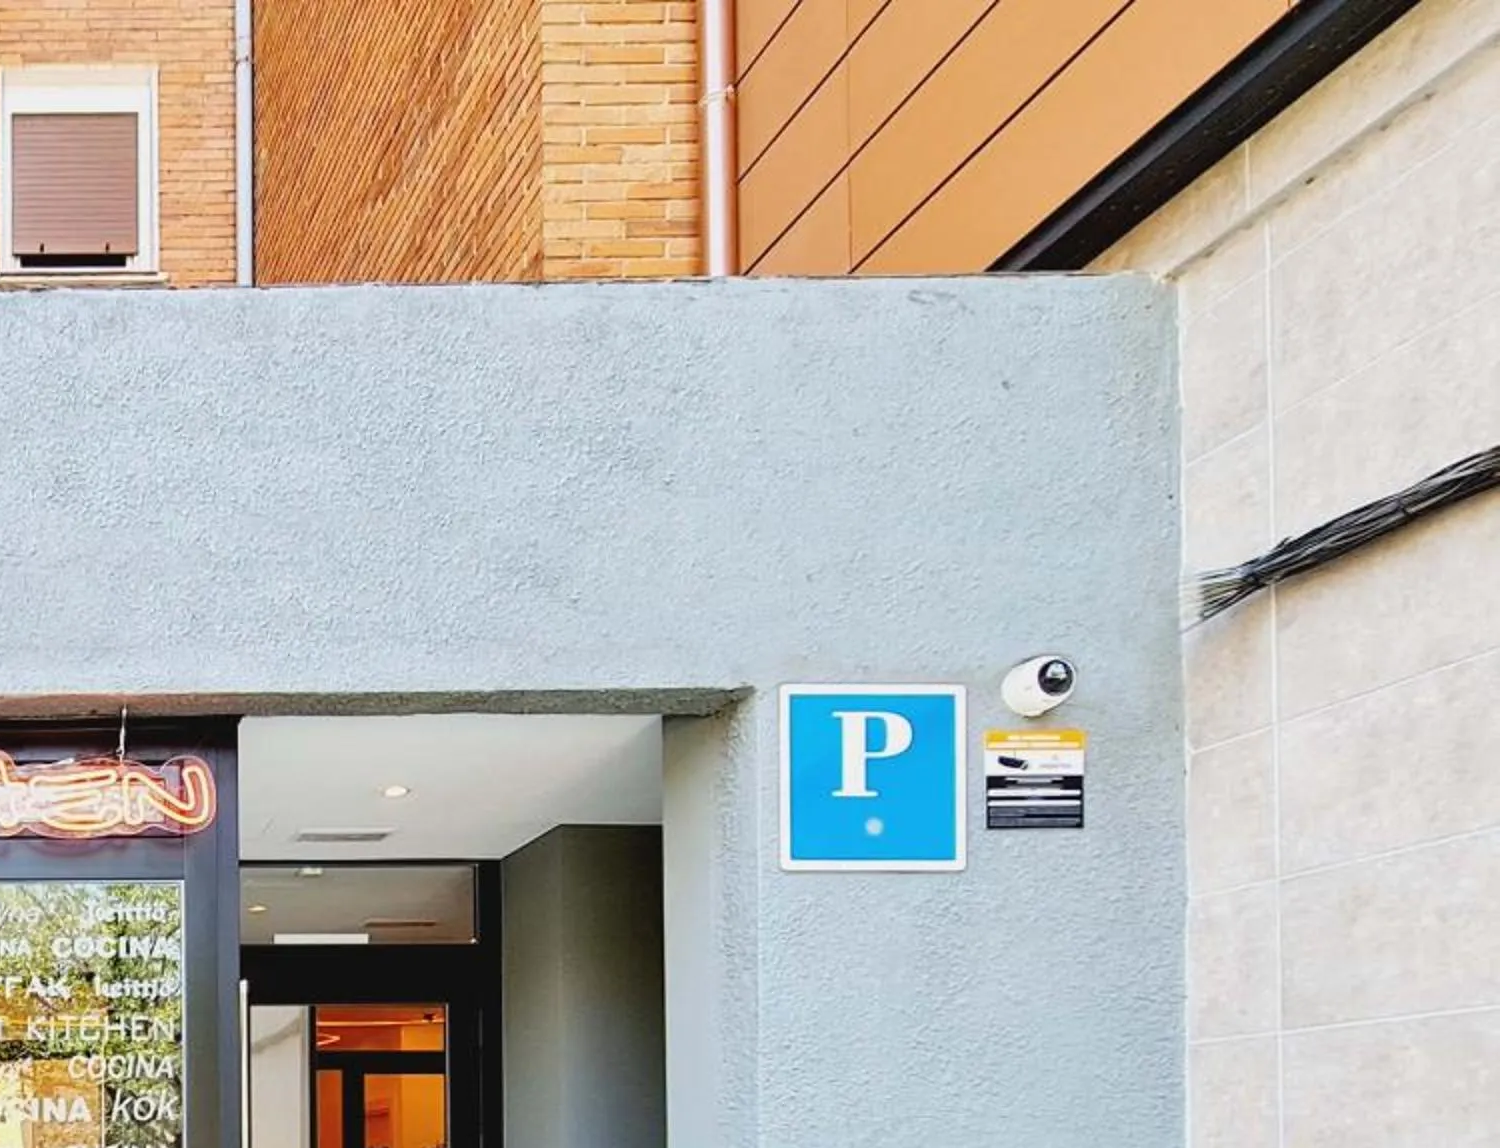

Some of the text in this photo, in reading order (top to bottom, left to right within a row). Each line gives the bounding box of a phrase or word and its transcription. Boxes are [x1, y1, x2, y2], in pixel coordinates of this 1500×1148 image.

[832, 711, 914, 797] P
[27, 1015, 176, 1041] KITCHEN
[68, 1054, 175, 1080] COCINA
